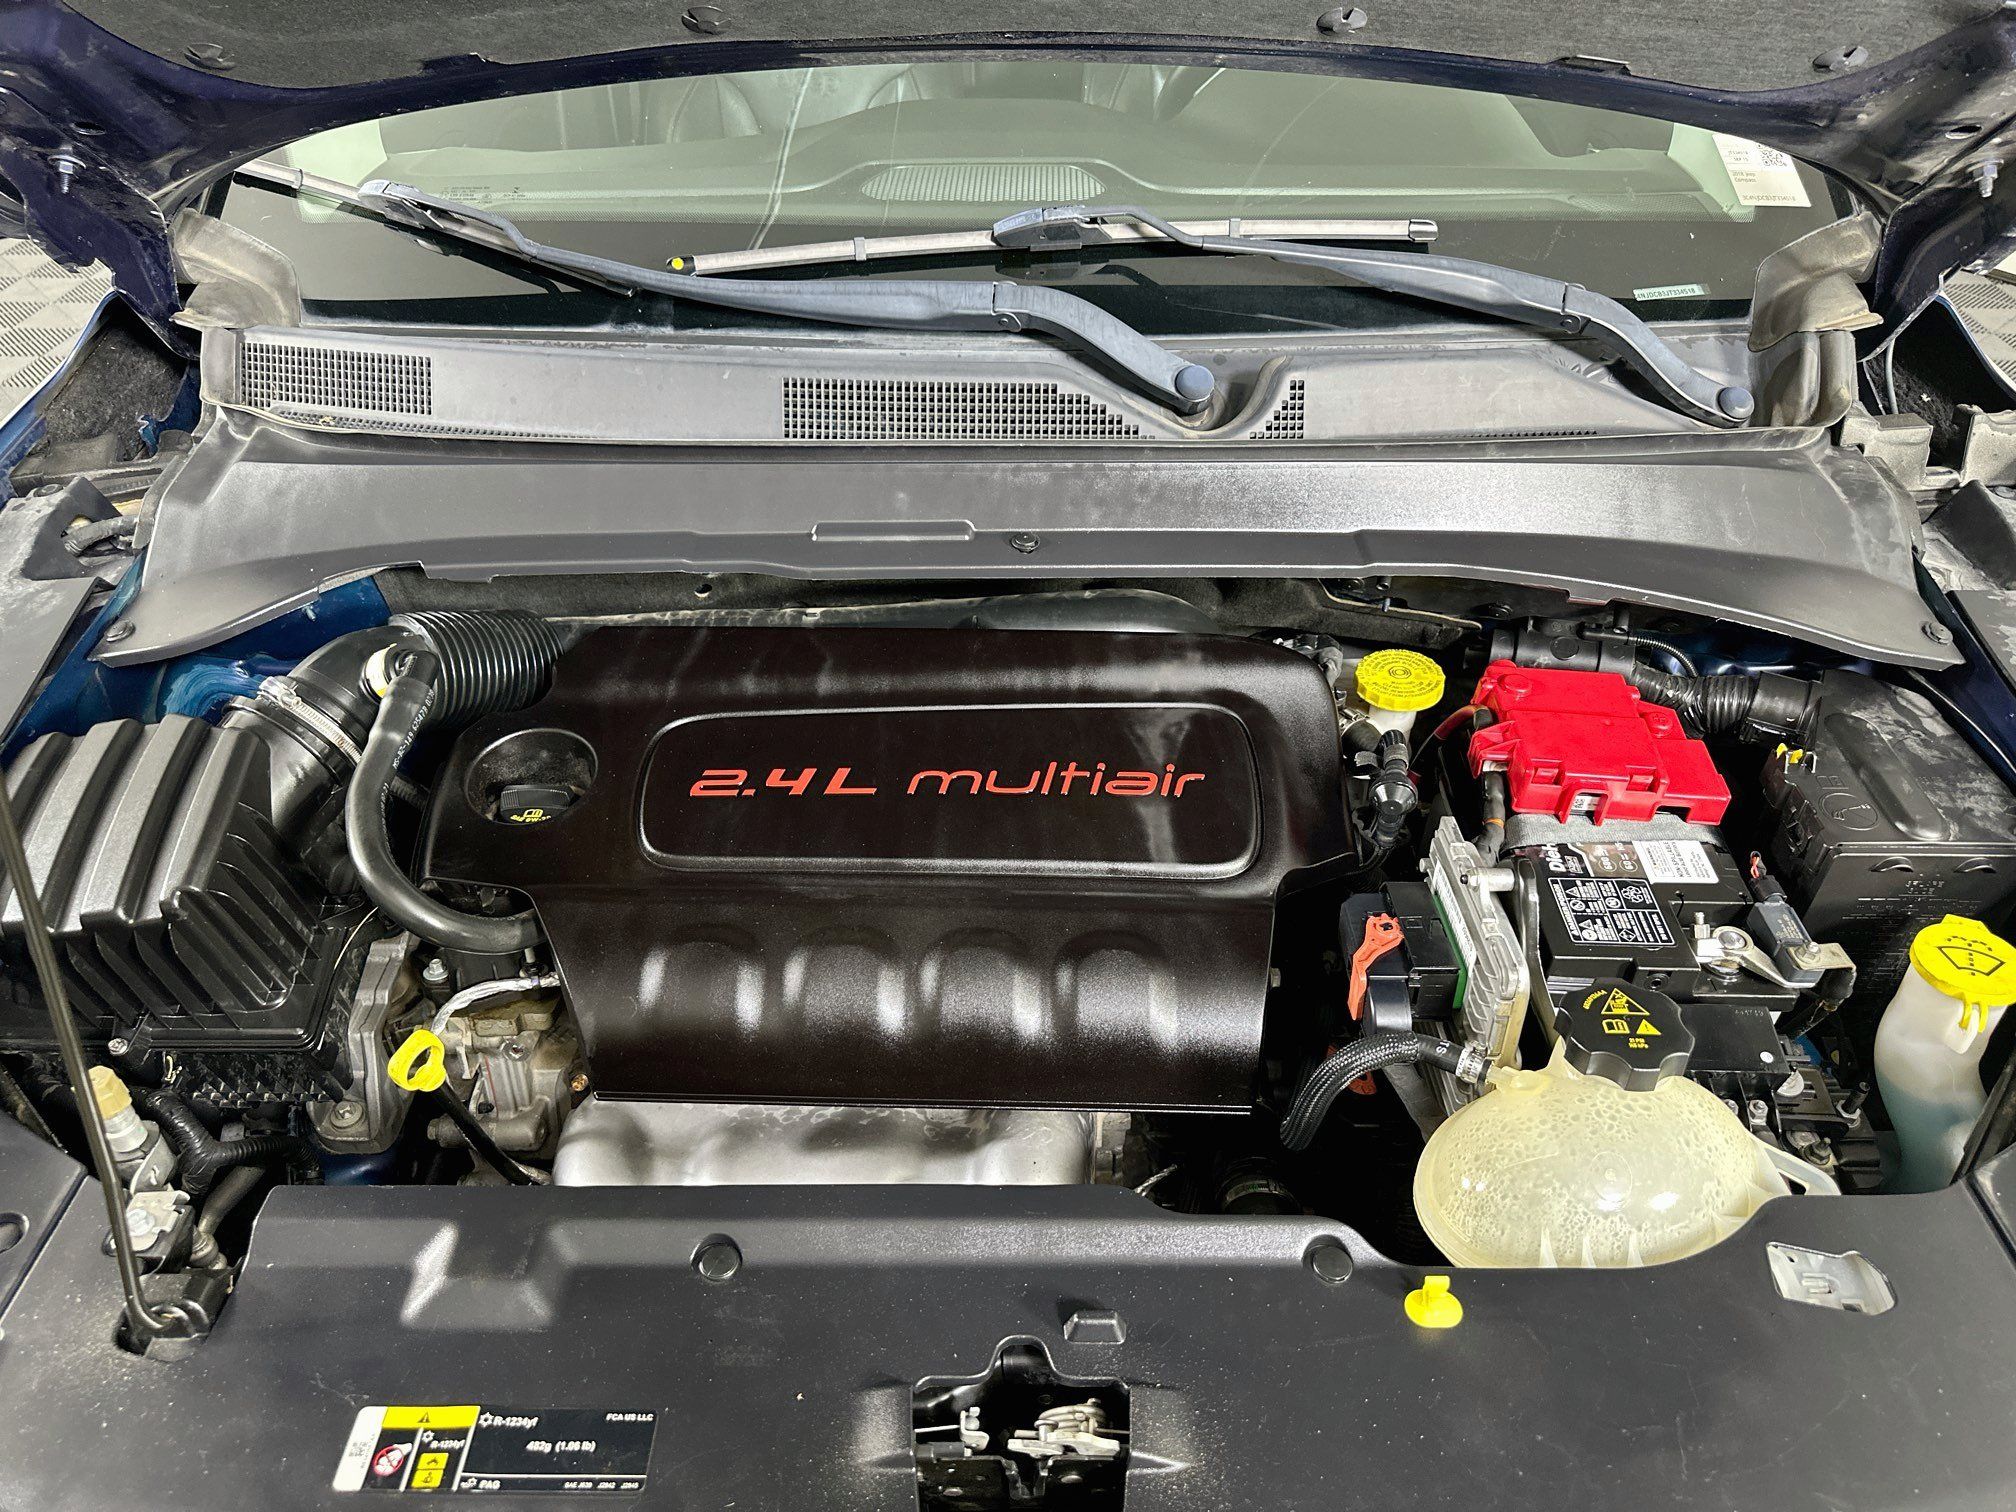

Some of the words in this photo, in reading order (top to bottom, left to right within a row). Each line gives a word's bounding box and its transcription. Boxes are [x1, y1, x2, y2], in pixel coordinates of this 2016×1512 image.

[906, 761, 1206, 799] multiair
[492, 1415, 539, 1430] R-1234yf
[605, 1412, 624, 1421] FCA
[624, 1412, 637, 1421] US
[637, 1413, 654, 1421] LLC
[525, 1440, 553, 1454] 482g
[478, 1479, 501, 1490] PAG
